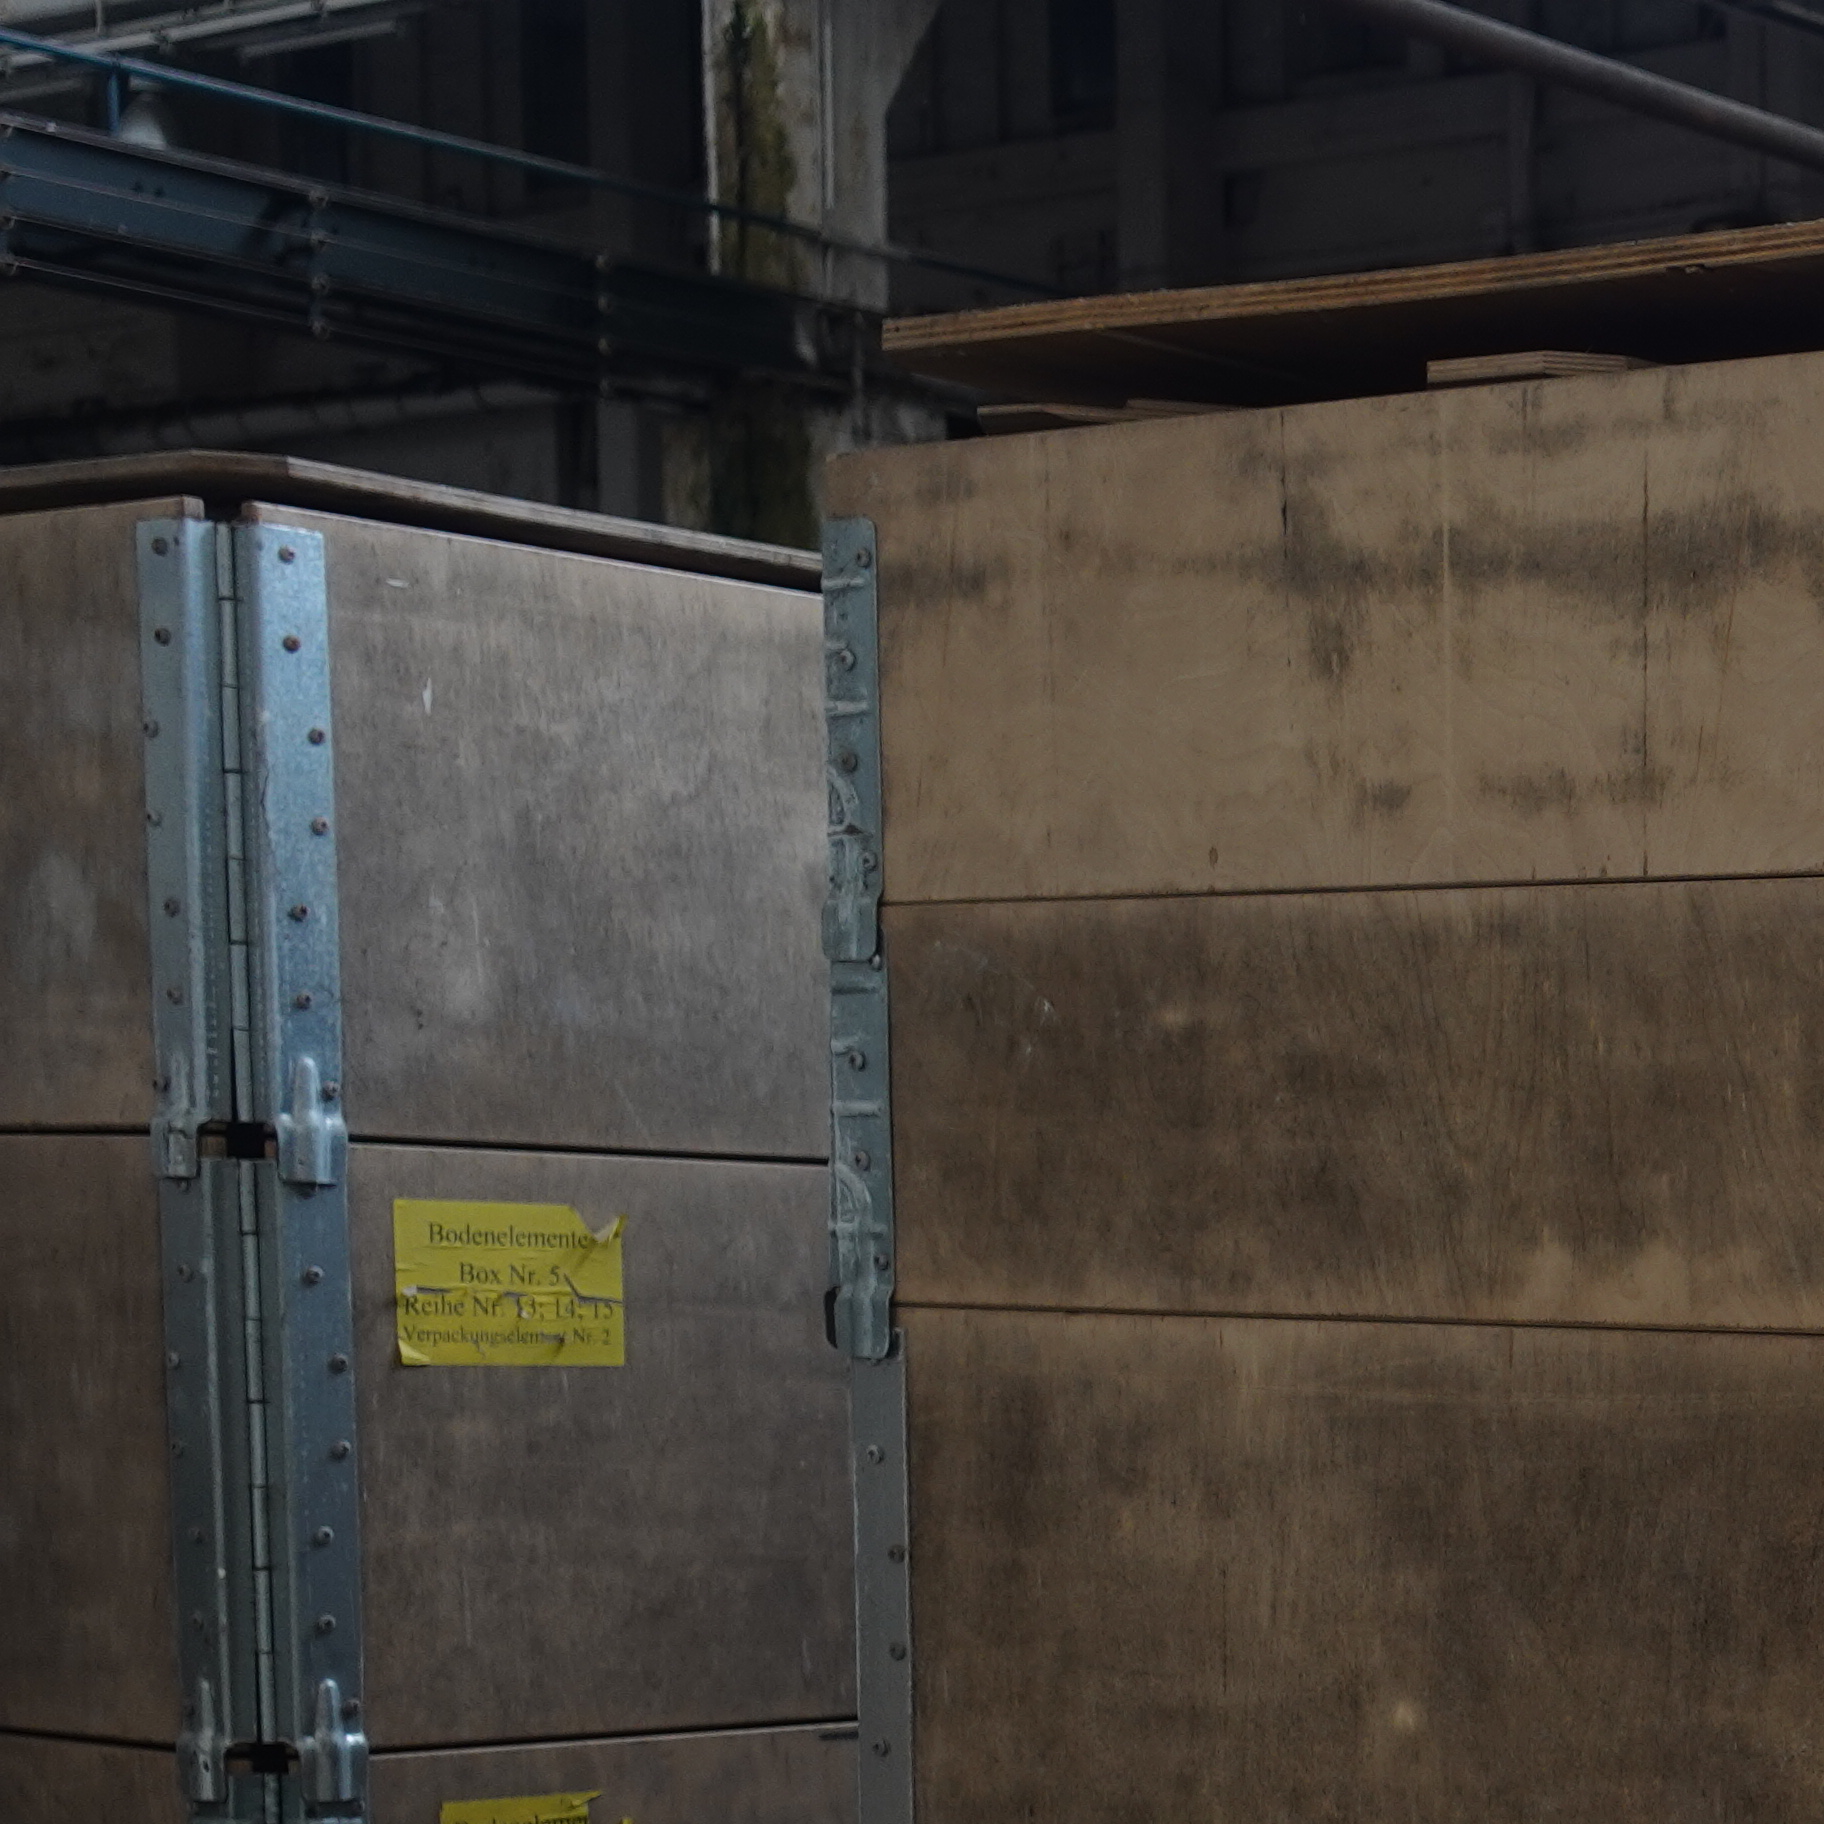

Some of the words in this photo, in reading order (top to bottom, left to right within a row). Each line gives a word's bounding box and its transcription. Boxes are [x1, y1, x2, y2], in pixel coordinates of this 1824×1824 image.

[429, 1223, 588, 1250] Bodenelemente
[460, 1262, 503, 1285] Box
[510, 1264, 541, 1285] Nr.
[550, 1266, 560, 1287] 5
[405, 1295, 465, 1316] Reihe
